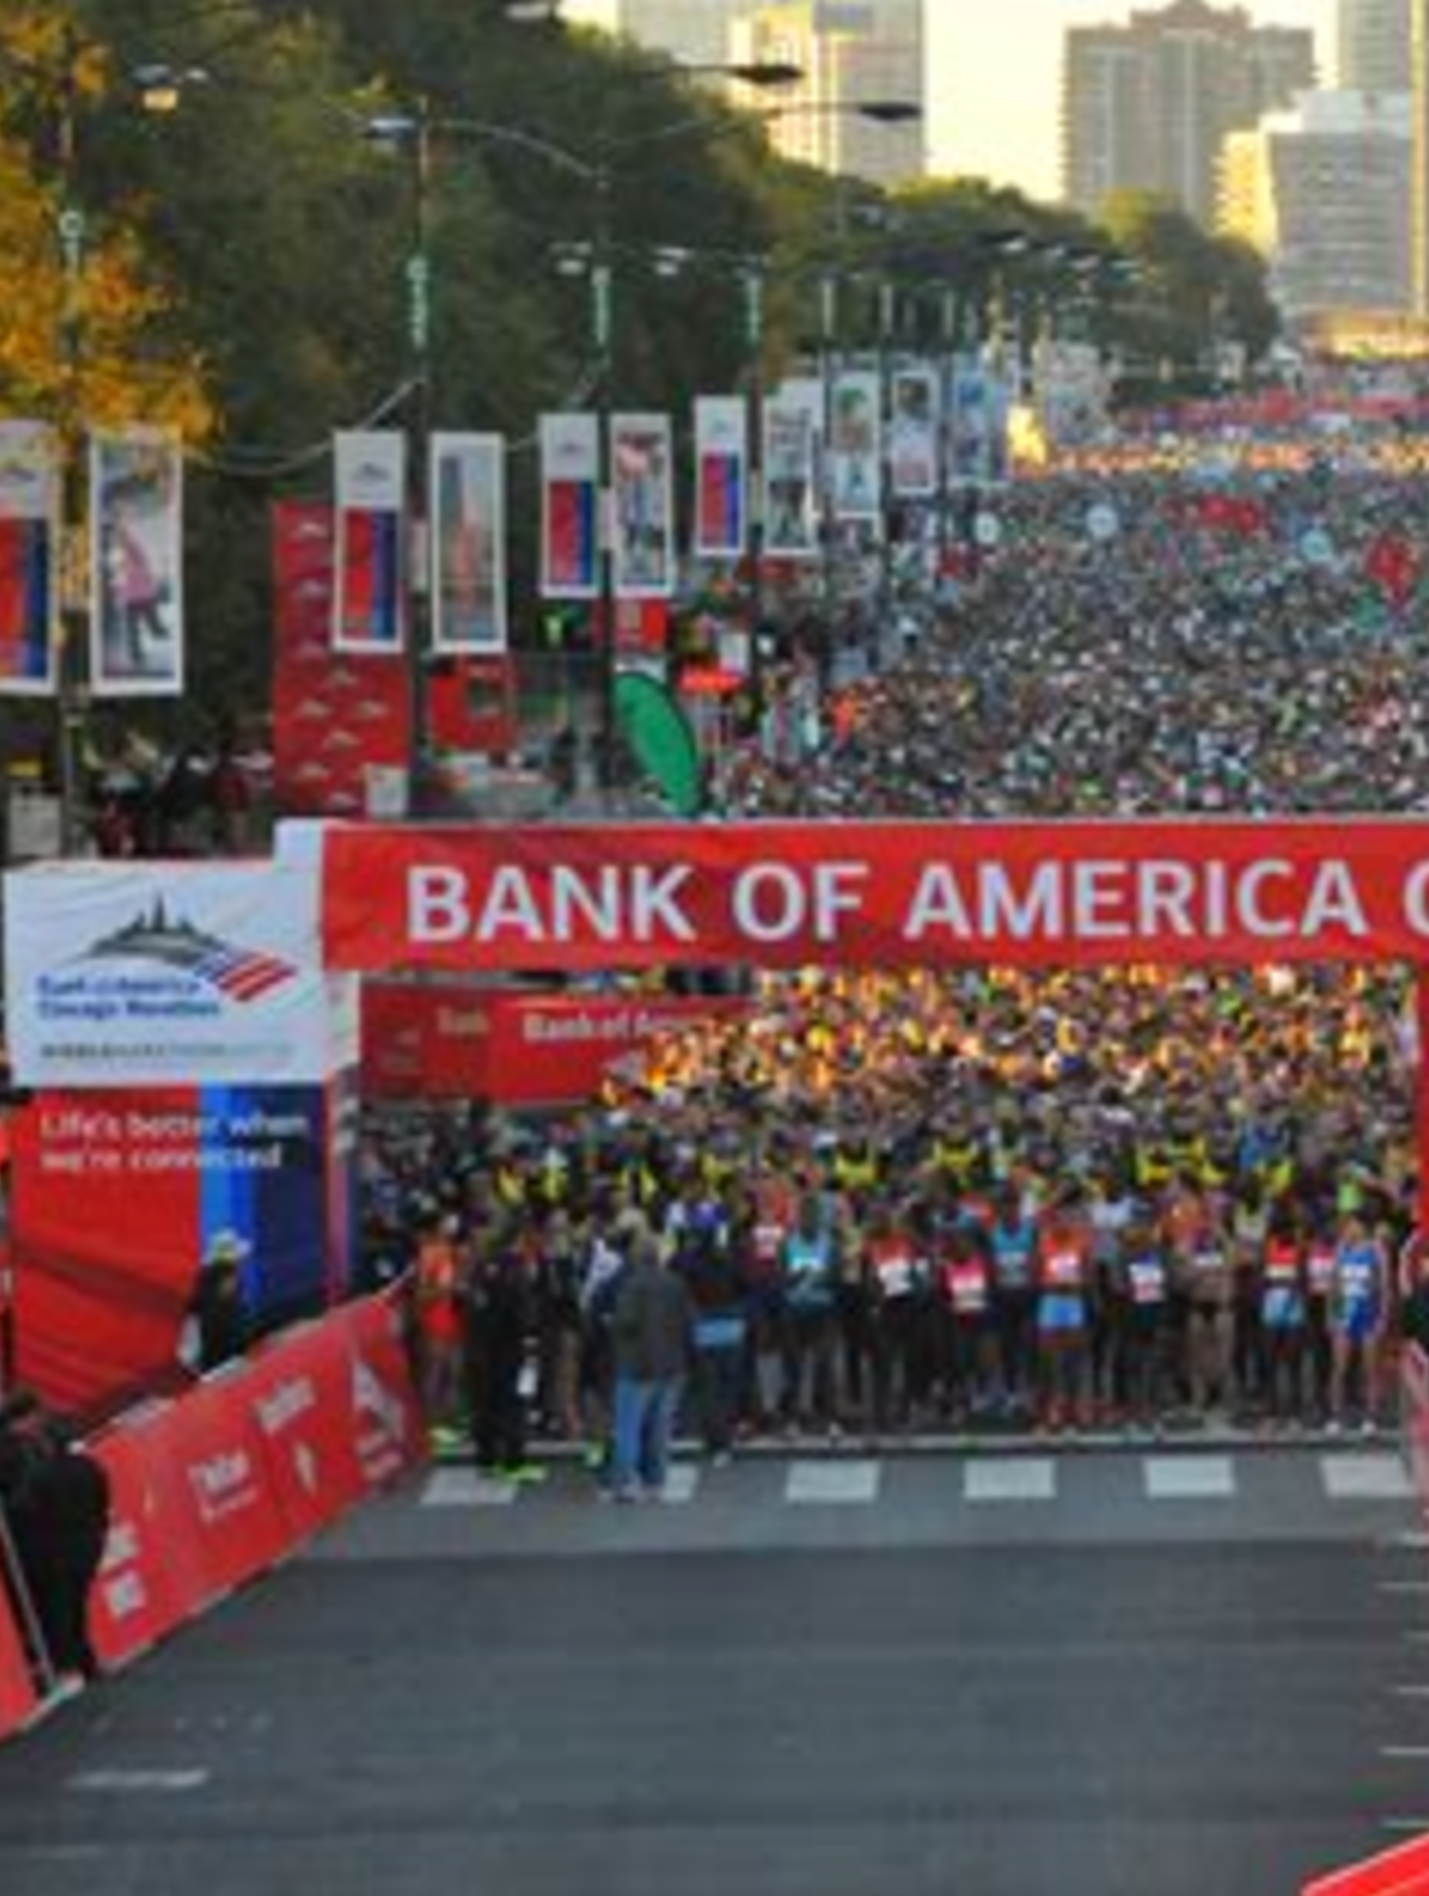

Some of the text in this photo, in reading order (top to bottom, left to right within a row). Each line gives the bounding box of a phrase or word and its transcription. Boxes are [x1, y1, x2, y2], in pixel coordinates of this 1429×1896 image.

[407, 864, 695, 941] BANK
[732, 862, 868, 939] OF
[903, 860, 1369, 938] AMERICA
